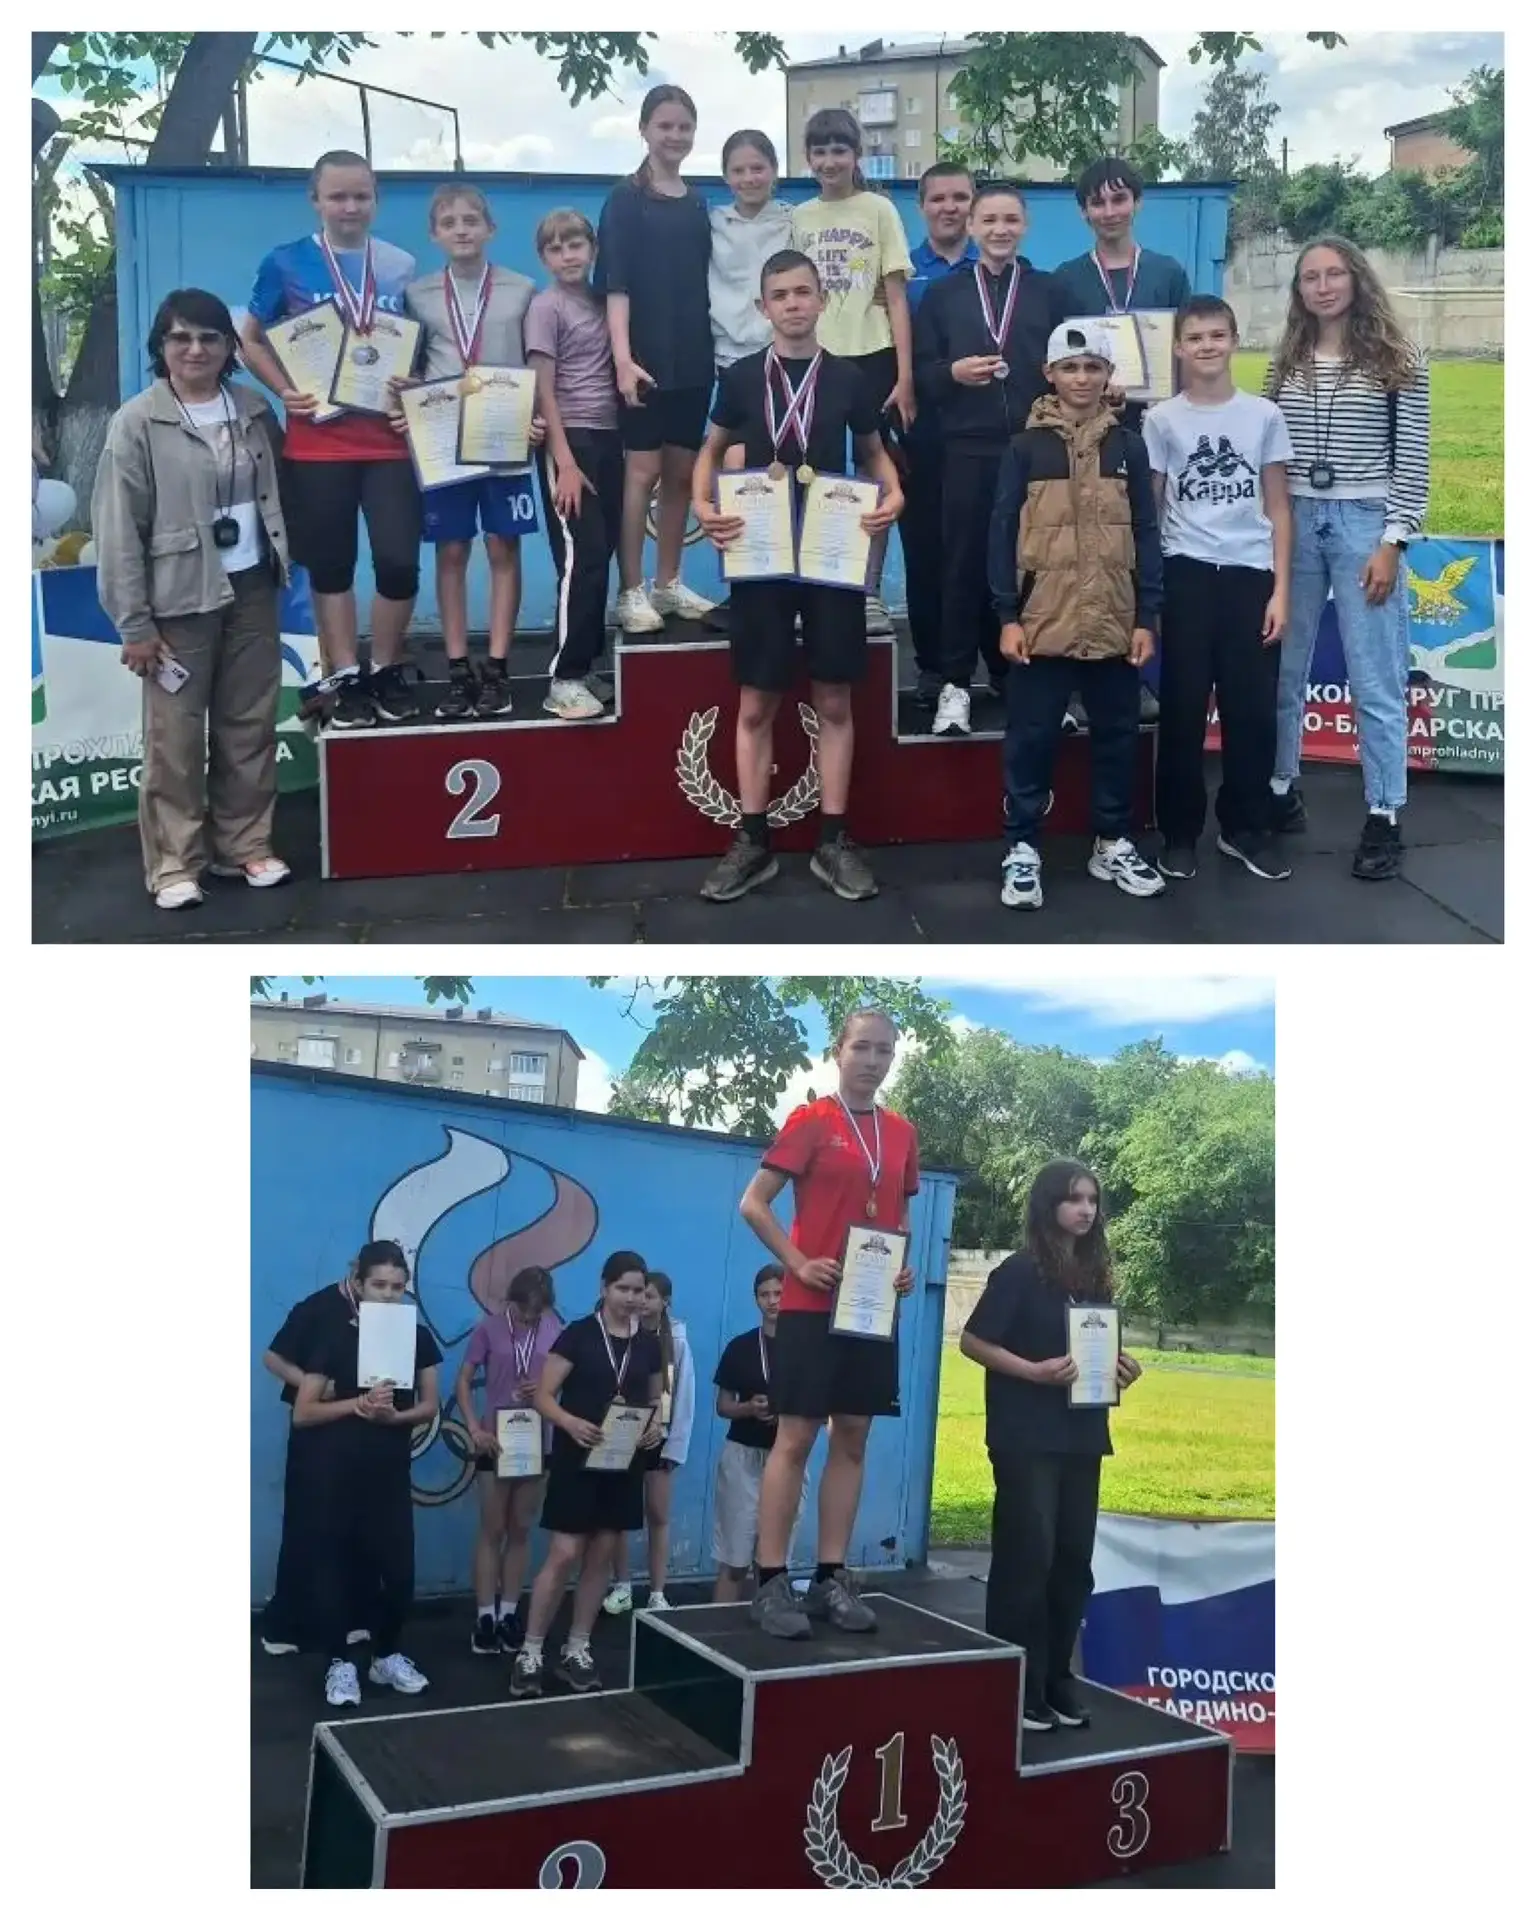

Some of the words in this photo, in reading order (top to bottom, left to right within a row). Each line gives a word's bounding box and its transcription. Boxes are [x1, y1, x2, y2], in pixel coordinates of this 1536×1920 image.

[1178, 478, 1256, 505] Kappa
[507, 493, 534, 521] 10
[1404, 688, 1461, 709] РУГ
[31, 775, 81, 805] АЯ
[445, 759, 502, 839] 2
[1147, 1666, 1276, 1694] ГОРОДСКО
[871, 1731, 908, 1832] 1
[1107, 1770, 1151, 1858] 3
